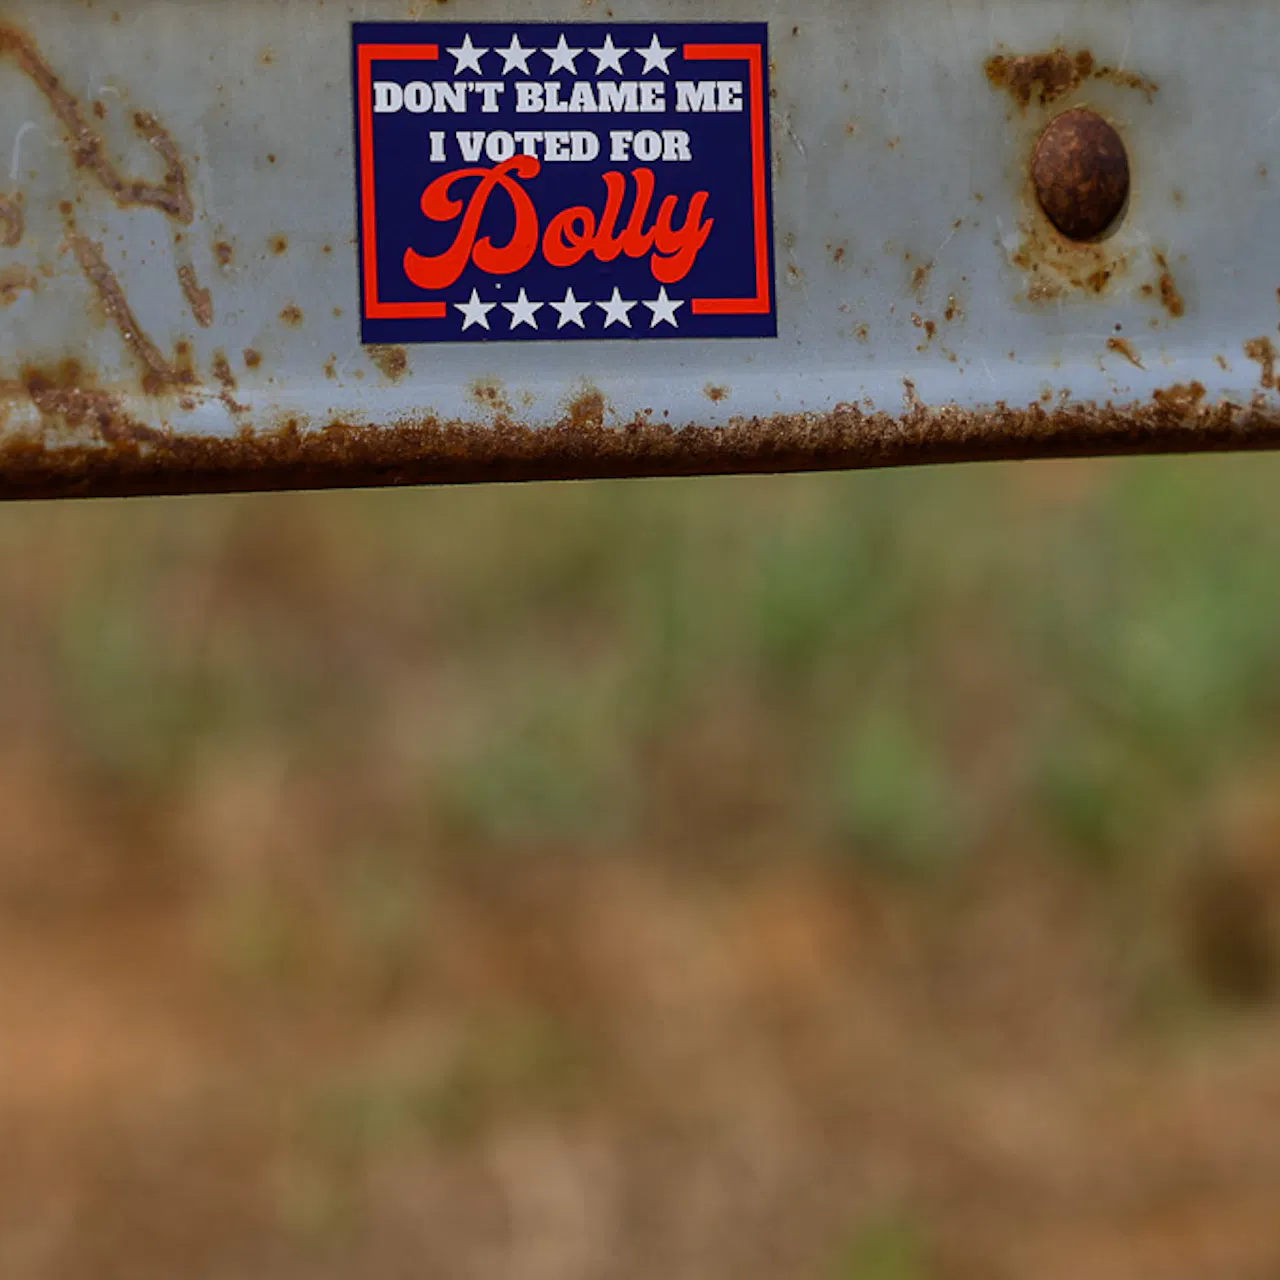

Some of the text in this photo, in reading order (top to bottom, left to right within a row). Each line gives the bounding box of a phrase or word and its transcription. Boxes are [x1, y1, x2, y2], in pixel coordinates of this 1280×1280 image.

[374, 81, 742, 112] DON'T BLAME ME
[430, 130, 692, 162] I VOTED FOR
[404, 154, 713, 289] Dolly
